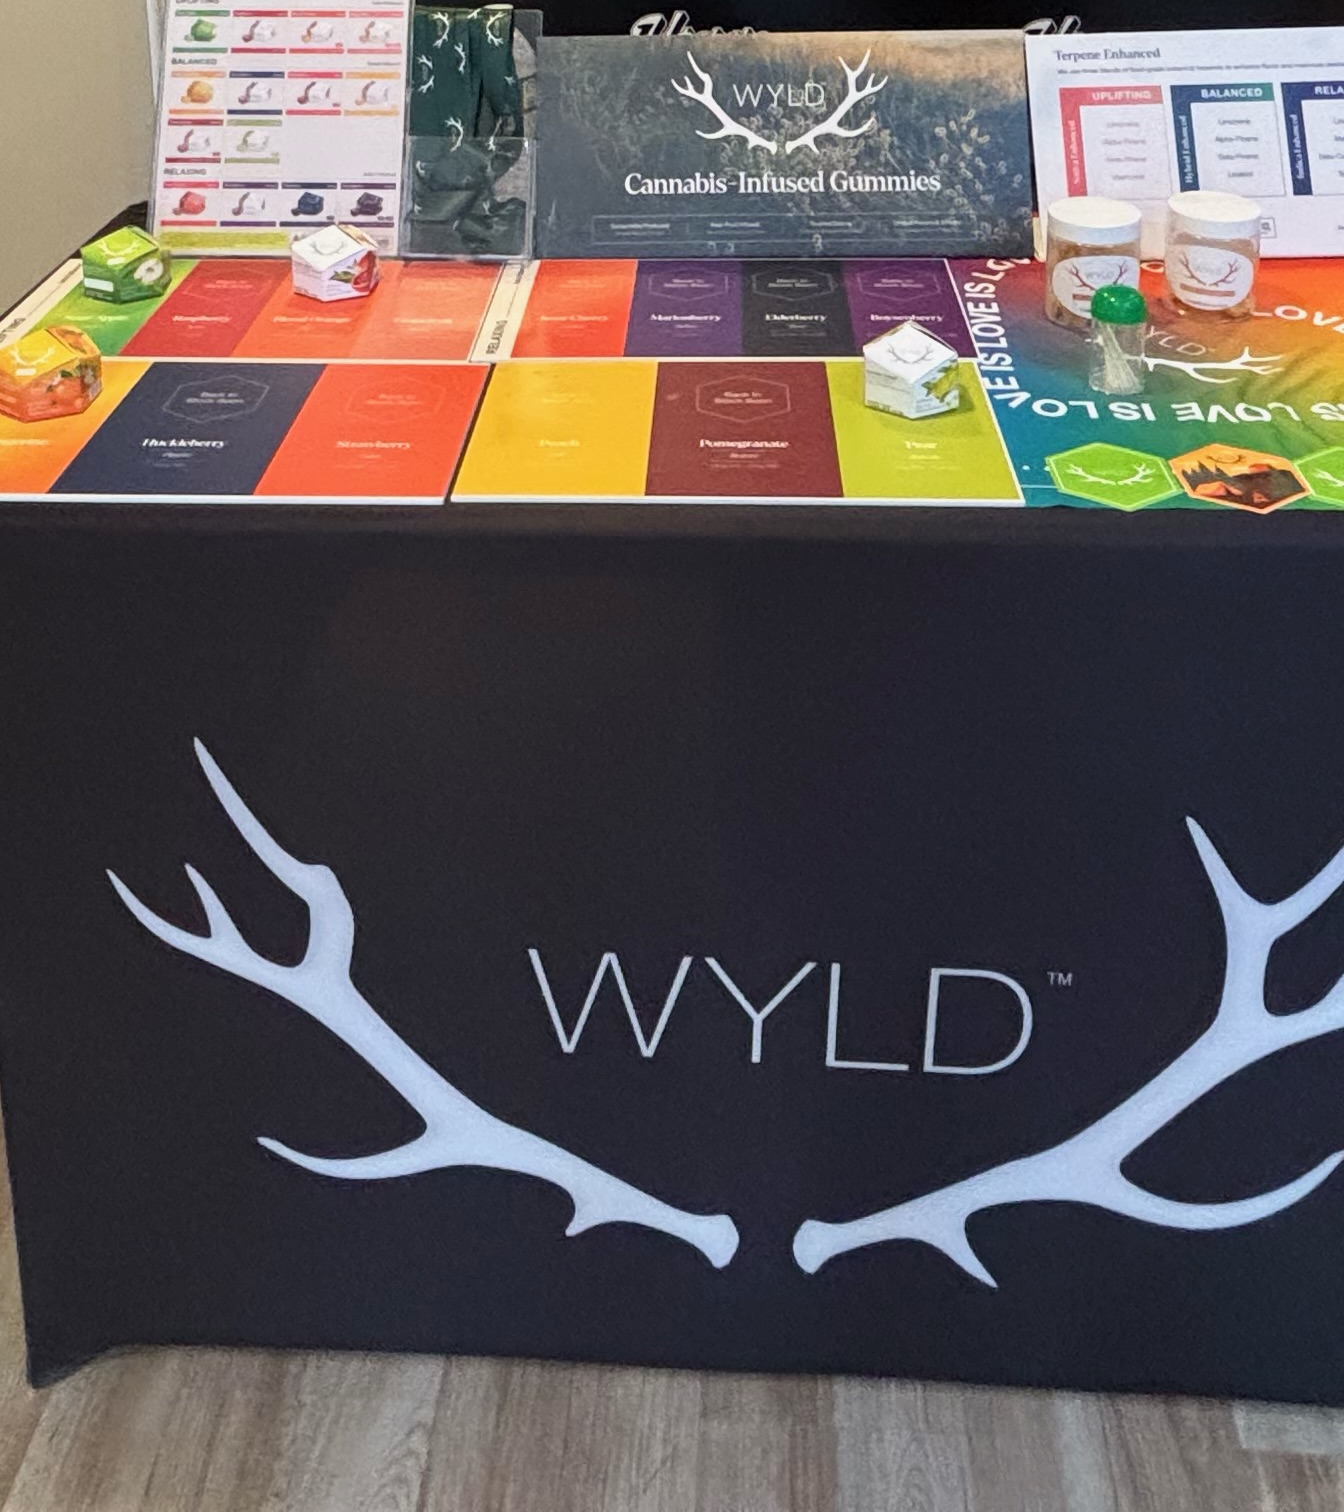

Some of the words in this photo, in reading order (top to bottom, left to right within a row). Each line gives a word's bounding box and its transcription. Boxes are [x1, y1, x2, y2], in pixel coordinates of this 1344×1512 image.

[1054, 49, 1101, 62] Terpene
[1103, 47, 1162, 60] Enhanced
[732, 82, 825, 108] WYLD
[1091, 90, 1152, 101] UPLIFTING
[1200, 88, 1263, 99] BALANCED
[624, 170, 825, 196] Cannabis-Infused
[829, 169, 942, 194] Gummies
[964, 281, 997, 299] IS
[967, 301, 1008, 349] LOVE
[1146, 324, 1207, 356] YLD
[977, 352, 1015, 372] IS
[1108, 402, 1157, 422] IS
[1170, 401, 1303, 424] LOVE
[699, 438, 790, 449] Pomegranate
[527, 947, 1034, 1076] WYLD
